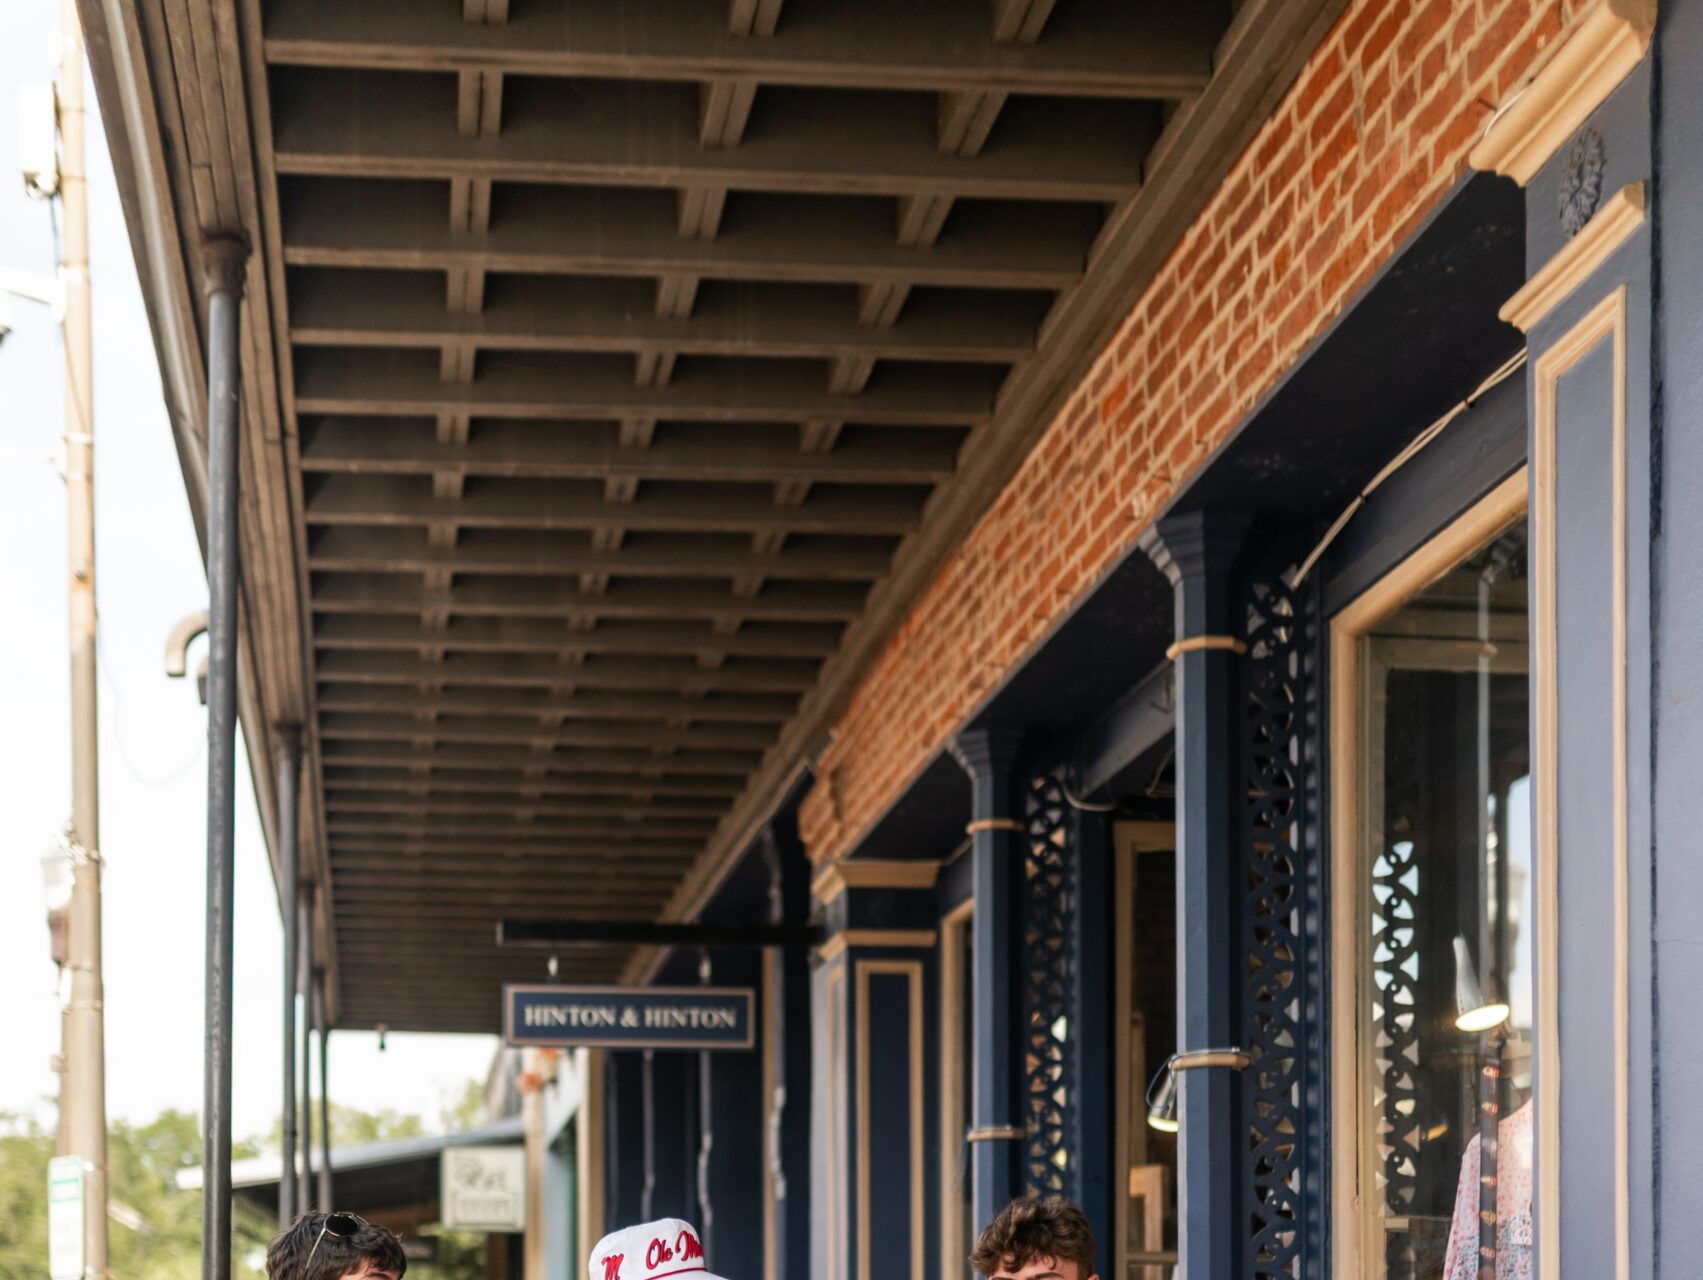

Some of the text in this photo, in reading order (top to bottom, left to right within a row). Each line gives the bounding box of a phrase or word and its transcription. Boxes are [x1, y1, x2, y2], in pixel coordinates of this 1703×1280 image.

[524, 1004, 736, 1029] HINTON & HINTON
[646, 1237, 673, 1270] Ole
